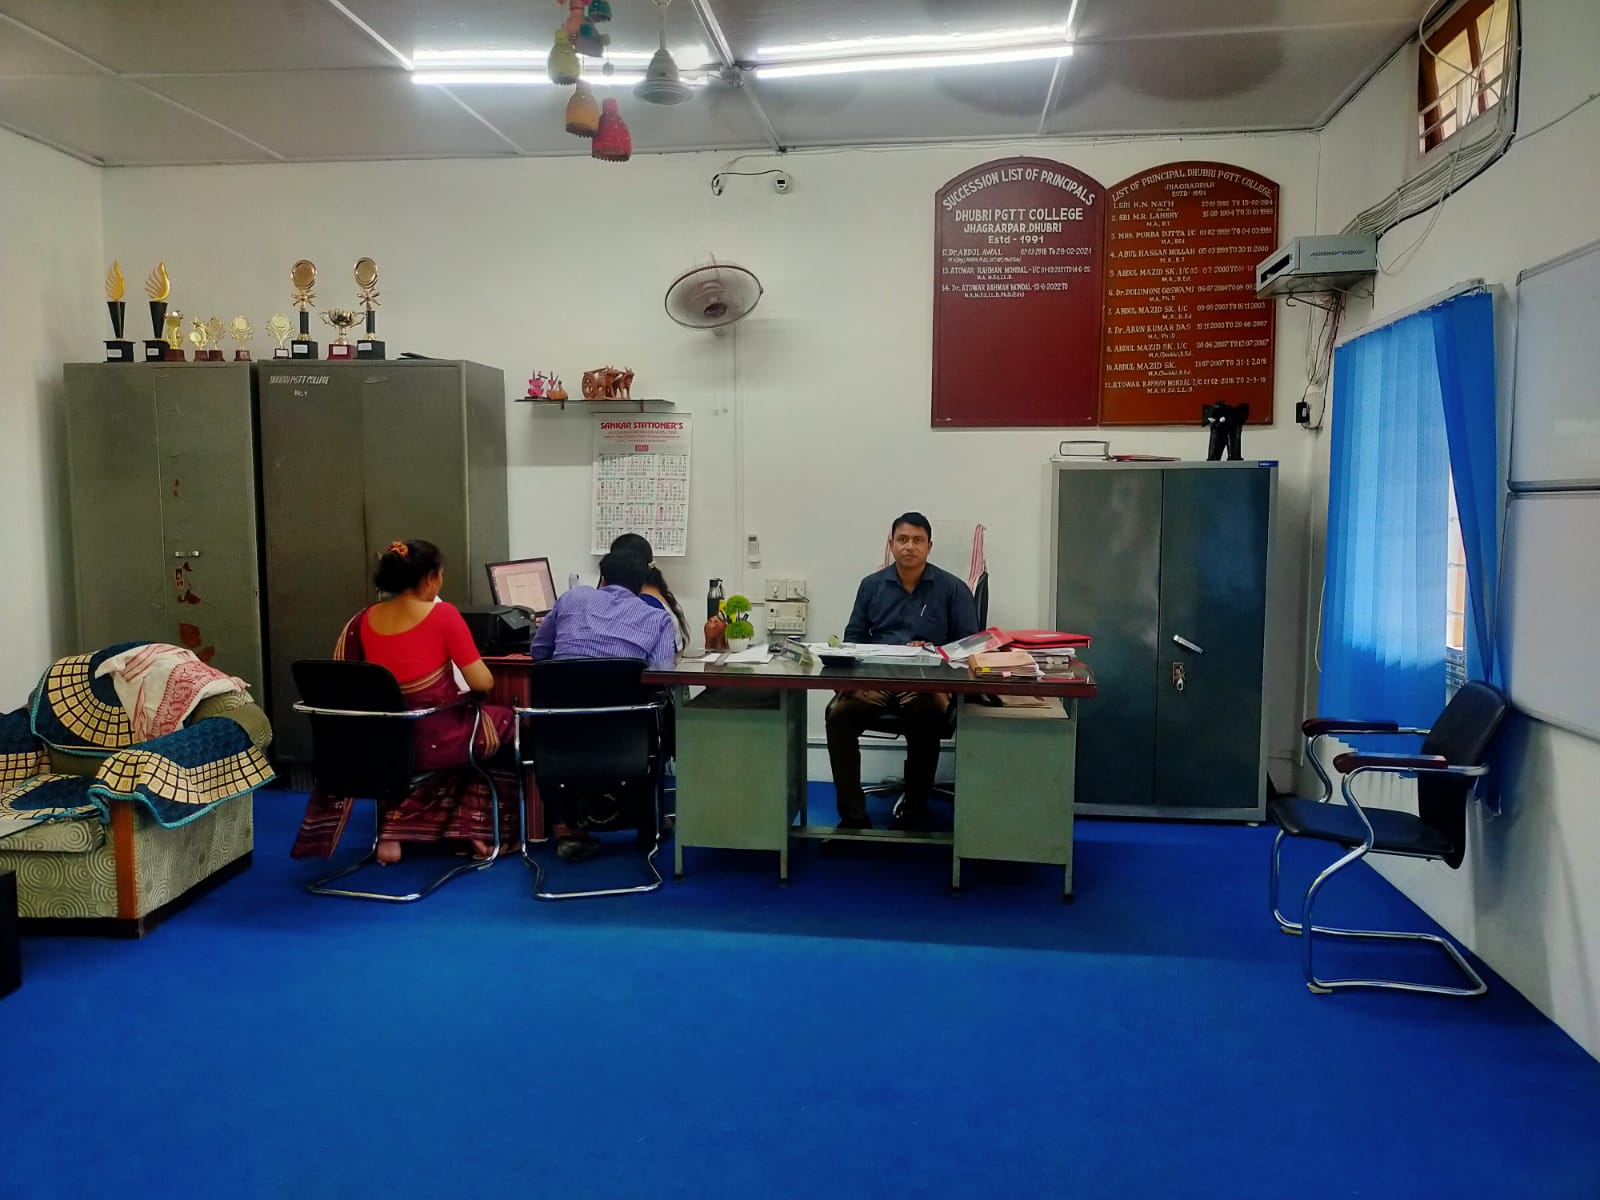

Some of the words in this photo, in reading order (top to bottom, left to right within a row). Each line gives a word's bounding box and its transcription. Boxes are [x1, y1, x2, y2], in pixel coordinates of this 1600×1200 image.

[942, 172, 1000, 211] SUCCESSION
[1001, 168, 1024, 182] LIST
[1025, 168, 1040, 181] OF
[1040, 169, 1095, 206] PRINCIPALS
[1111, 186, 1130, 202] LIST
[1130, 180, 1140, 191] OF
[1187, 168, 1216, 178] DHUBRI
[955, 208, 992, 222] DHUBRI
[994, 208, 1026, 222] PGTT
[1029, 207, 1084, 221] COLLEGE
[988, 235, 1011, 244] Estd
[1019, 235, 1044, 244] 1991
[1138, 250, 1168, 258] HASSAN
[1139, 268, 1164, 276] MAZID
[1138, 306, 1162, 314] MAZID
[1147, 324, 1174, 333] KUMAR
[1175, 323, 1192, 331] DAS
[1136, 343, 1161, 351] MAZID
[1136, 362, 1162, 370] MAZID
[600, 421, 632, 430] SANKAR
[633, 421, 684, 430] STATIONER'S
